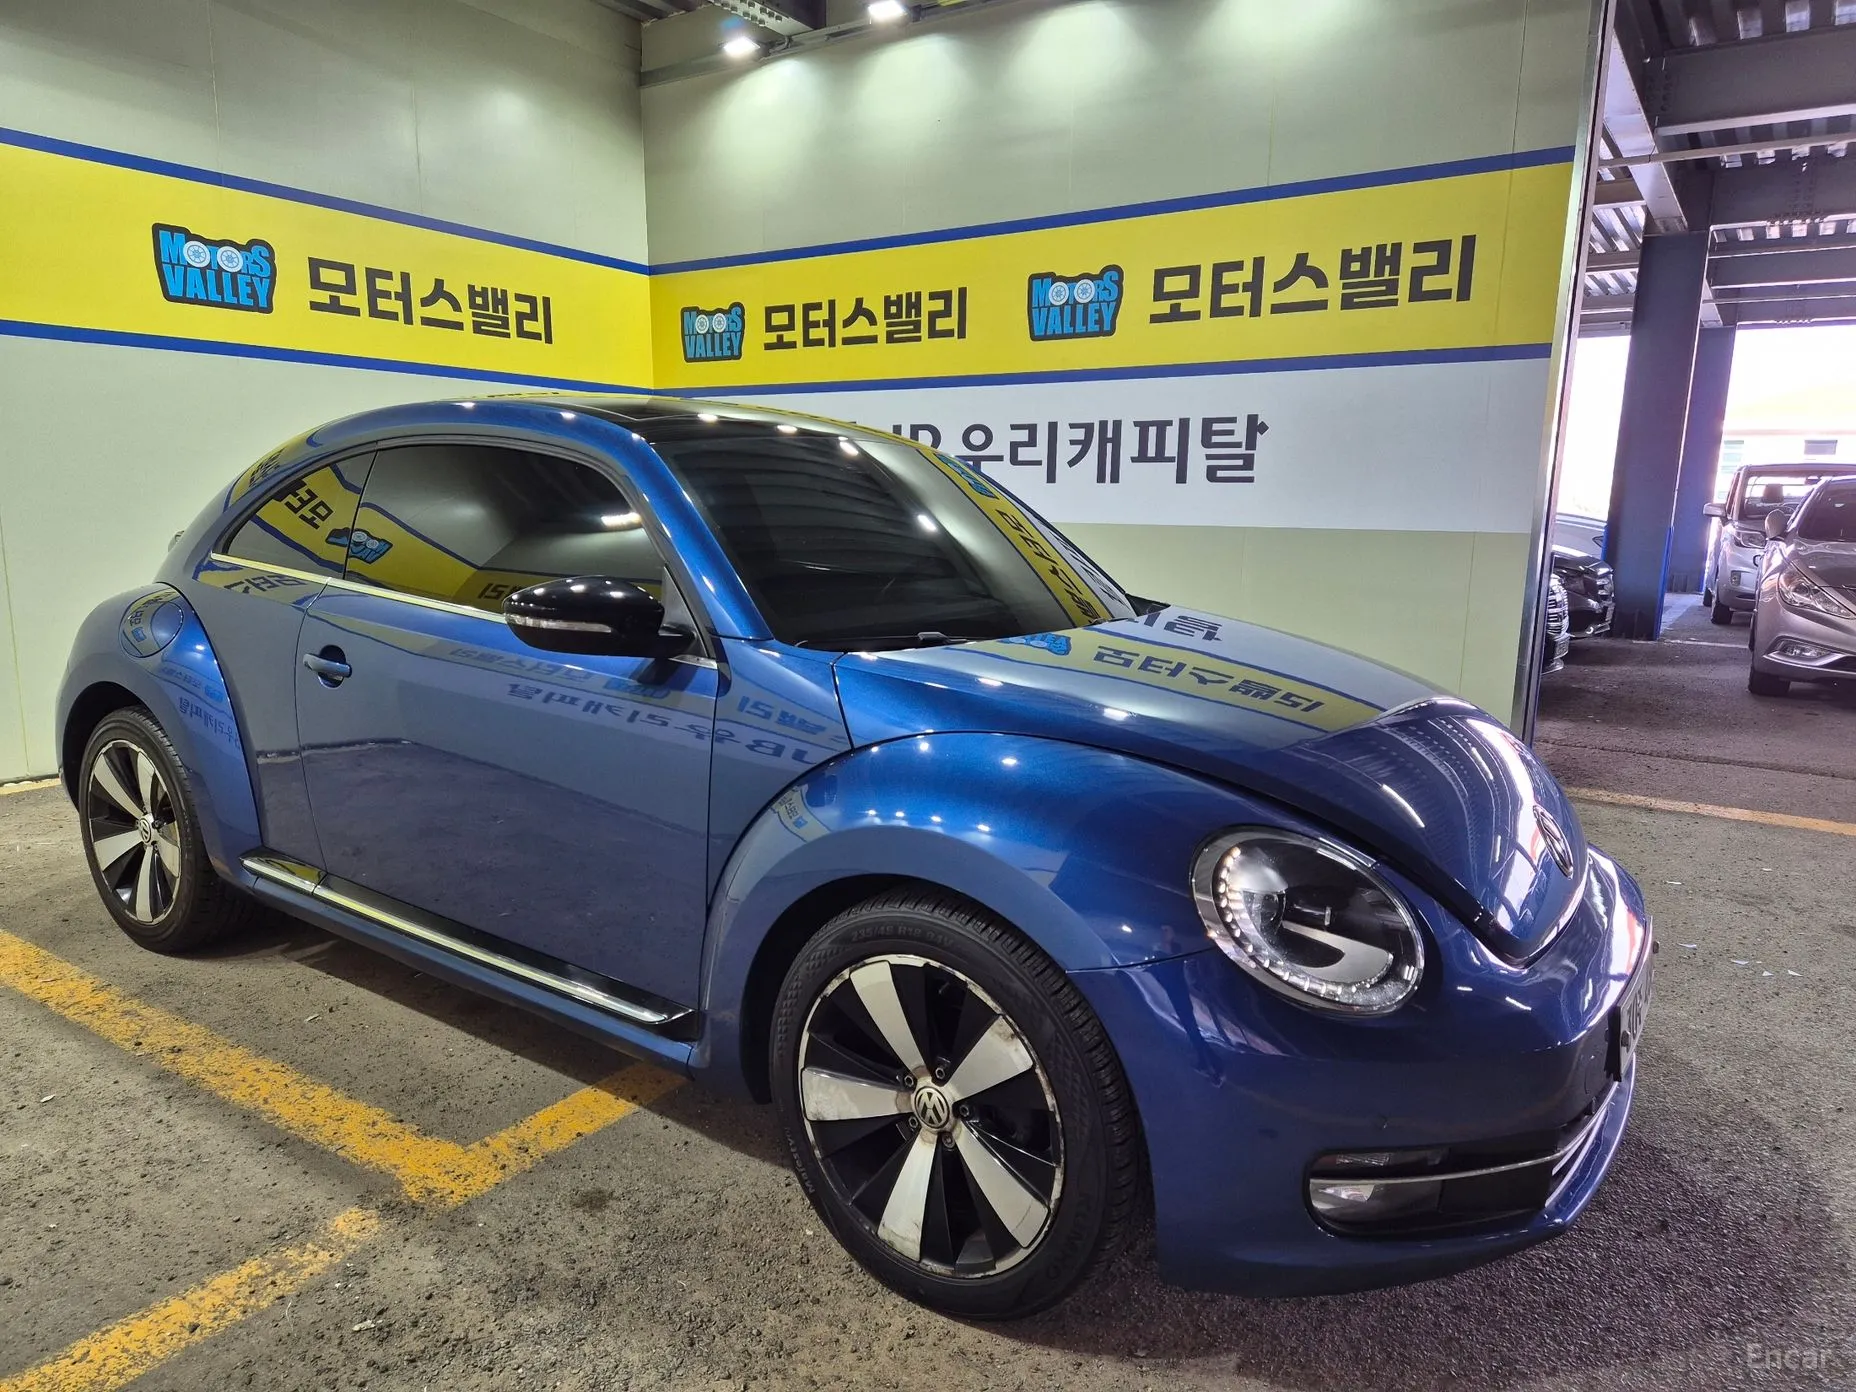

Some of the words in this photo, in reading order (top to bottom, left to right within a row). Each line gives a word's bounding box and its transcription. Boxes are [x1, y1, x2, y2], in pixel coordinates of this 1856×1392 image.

[159, 229, 270, 278] MOTORS
[162, 263, 270, 308] VALLEY
[308, 256, 553, 345] 모터스밸리
[1032, 270, 1119, 306] MOTORS
[1149, 235, 1477, 325] 모터스밸리
[684, 306, 742, 335] MOTORS
[764, 287, 967, 351] 모터스밸리
[1032, 302, 1117, 336] VALLEY
[685, 332, 741, 358] VALLEY
[954, 413, 1269, 484] 우리캐피탈
